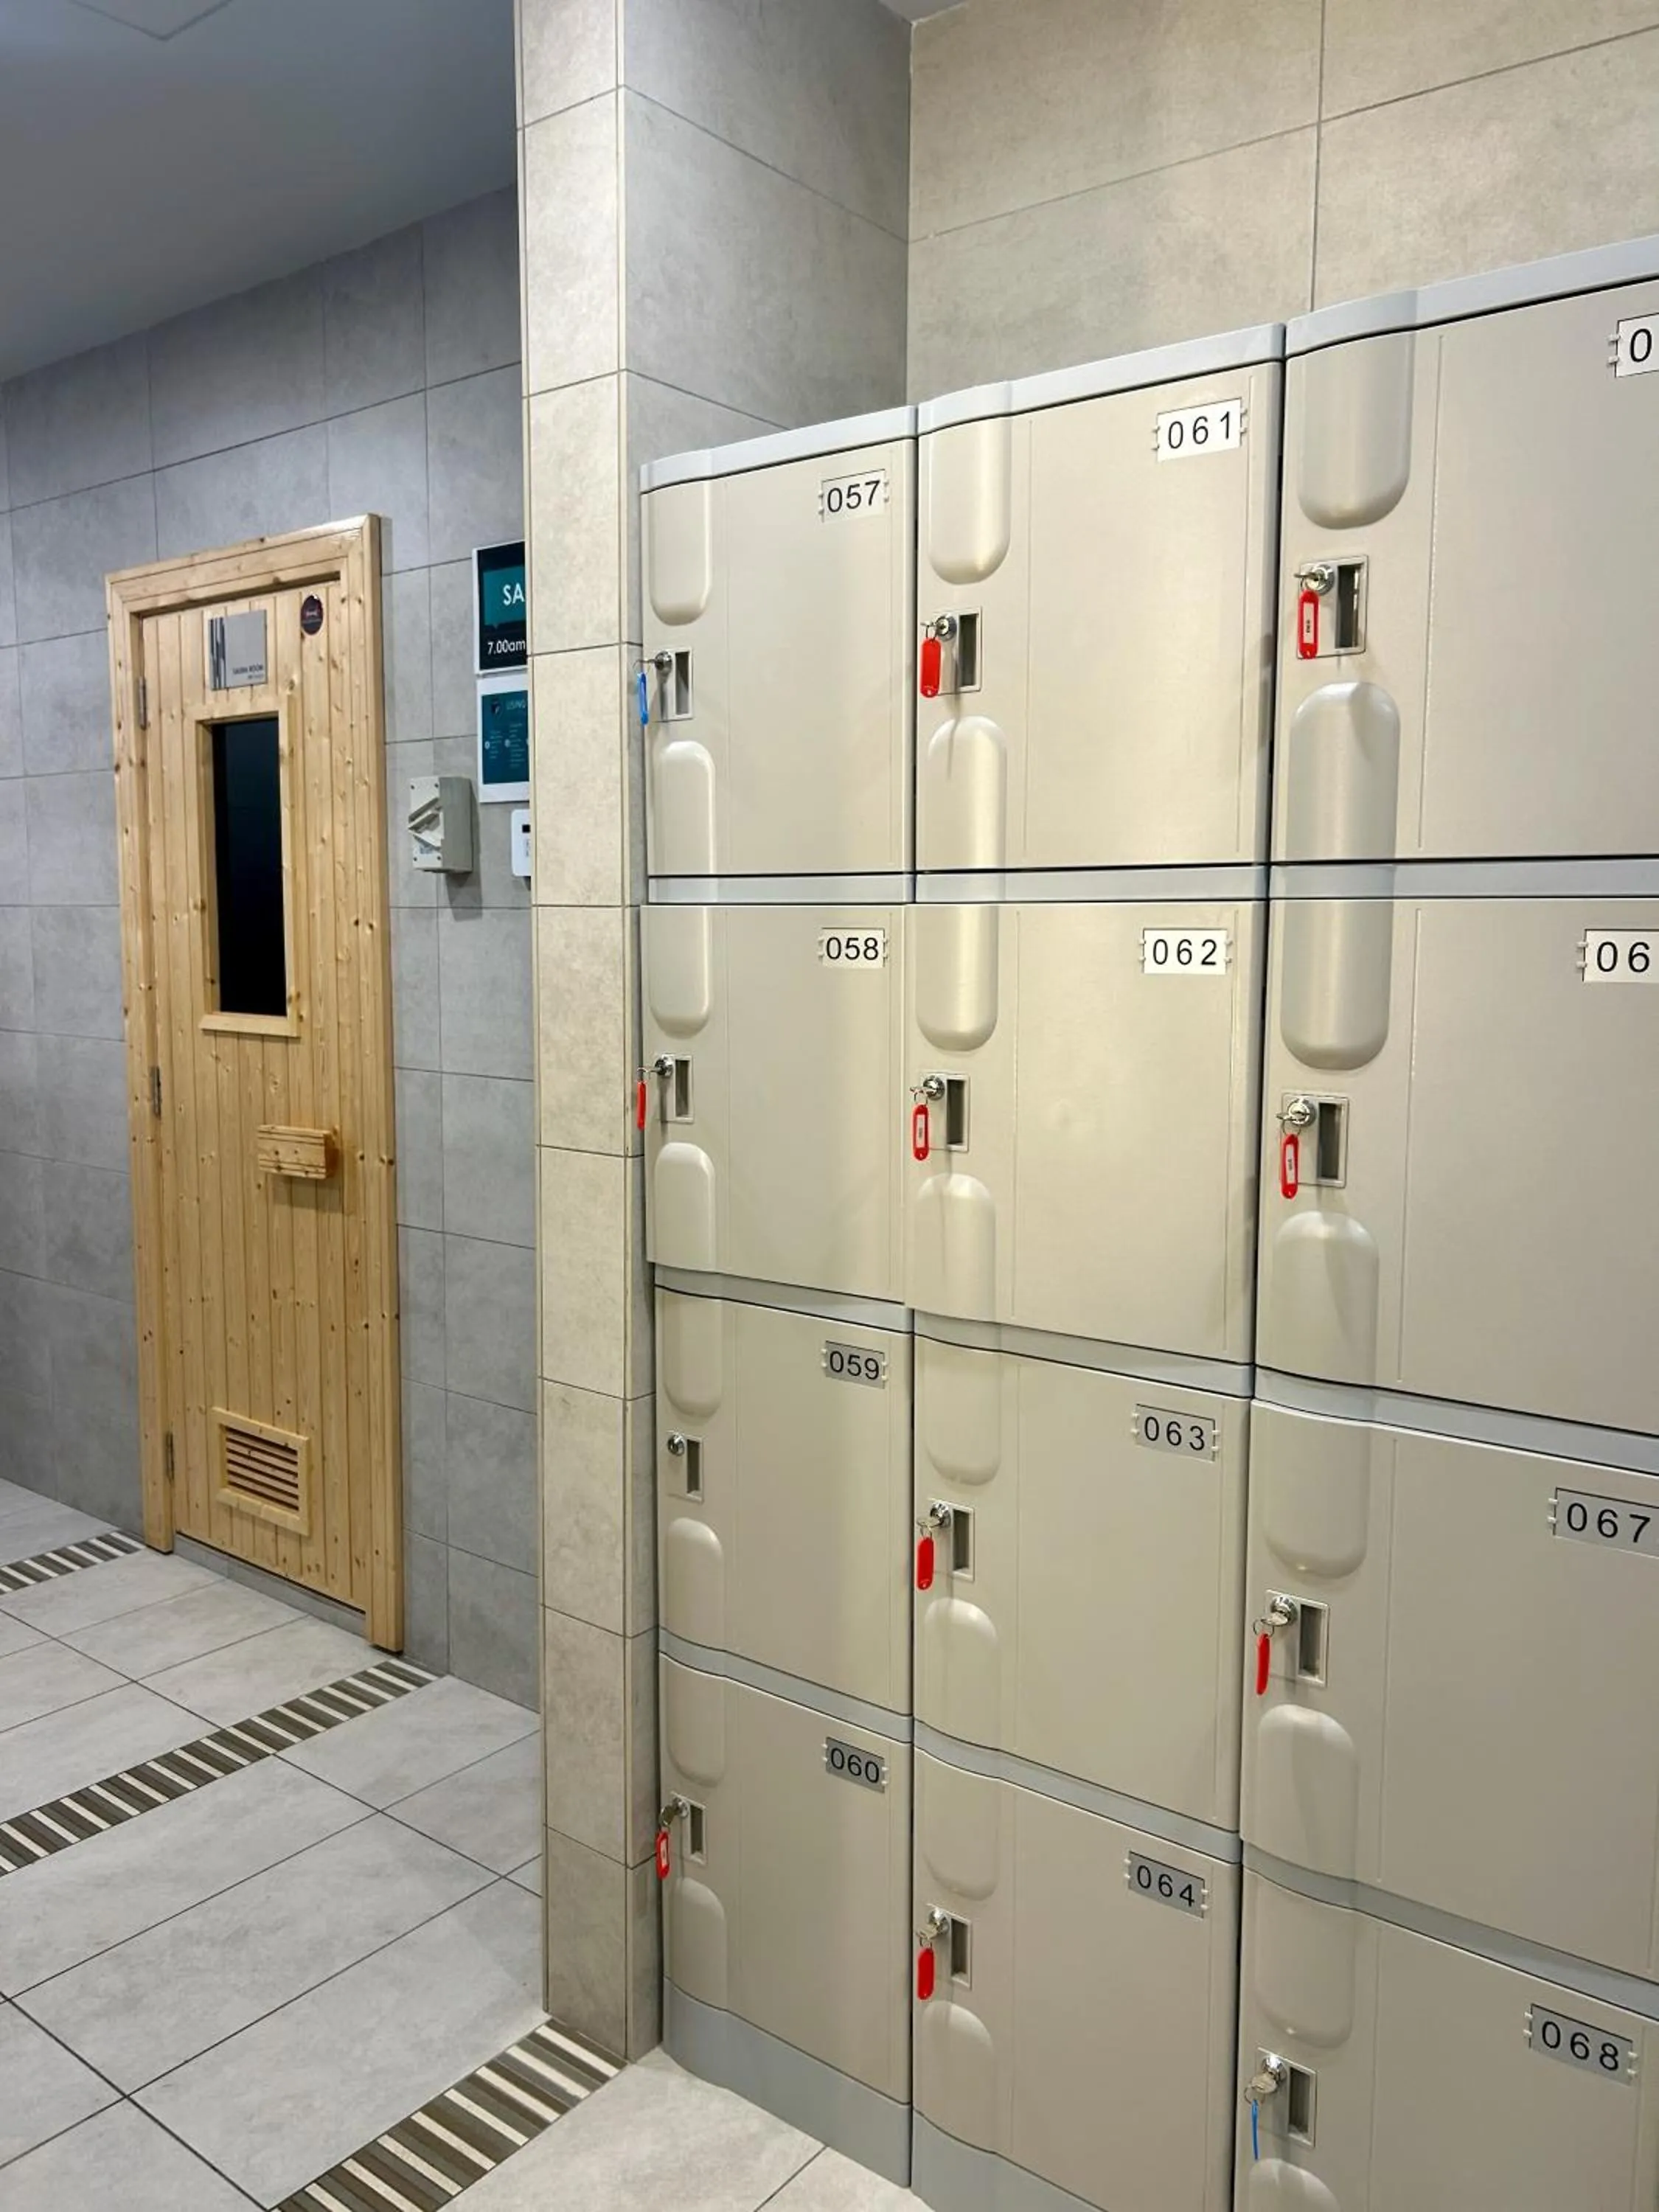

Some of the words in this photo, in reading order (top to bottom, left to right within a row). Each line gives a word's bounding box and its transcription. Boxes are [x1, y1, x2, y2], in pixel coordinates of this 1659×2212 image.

[1168, 411, 1230, 449] 061
[827, 479, 880, 513] 057
[487, 639, 526, 655] 7.00am
[826, 936, 879, 961] 058
[1152, 939, 1217, 966] 062
[830, 1350, 880, 1380] 059
[1144, 1416, 1205, 1451] 063
[1567, 1502, 1651, 1543] 067
[830, 1747, 880, 1784] 060
[1136, 1865, 1195, 1907] 064
[1541, 2020, 1619, 2071] 068
